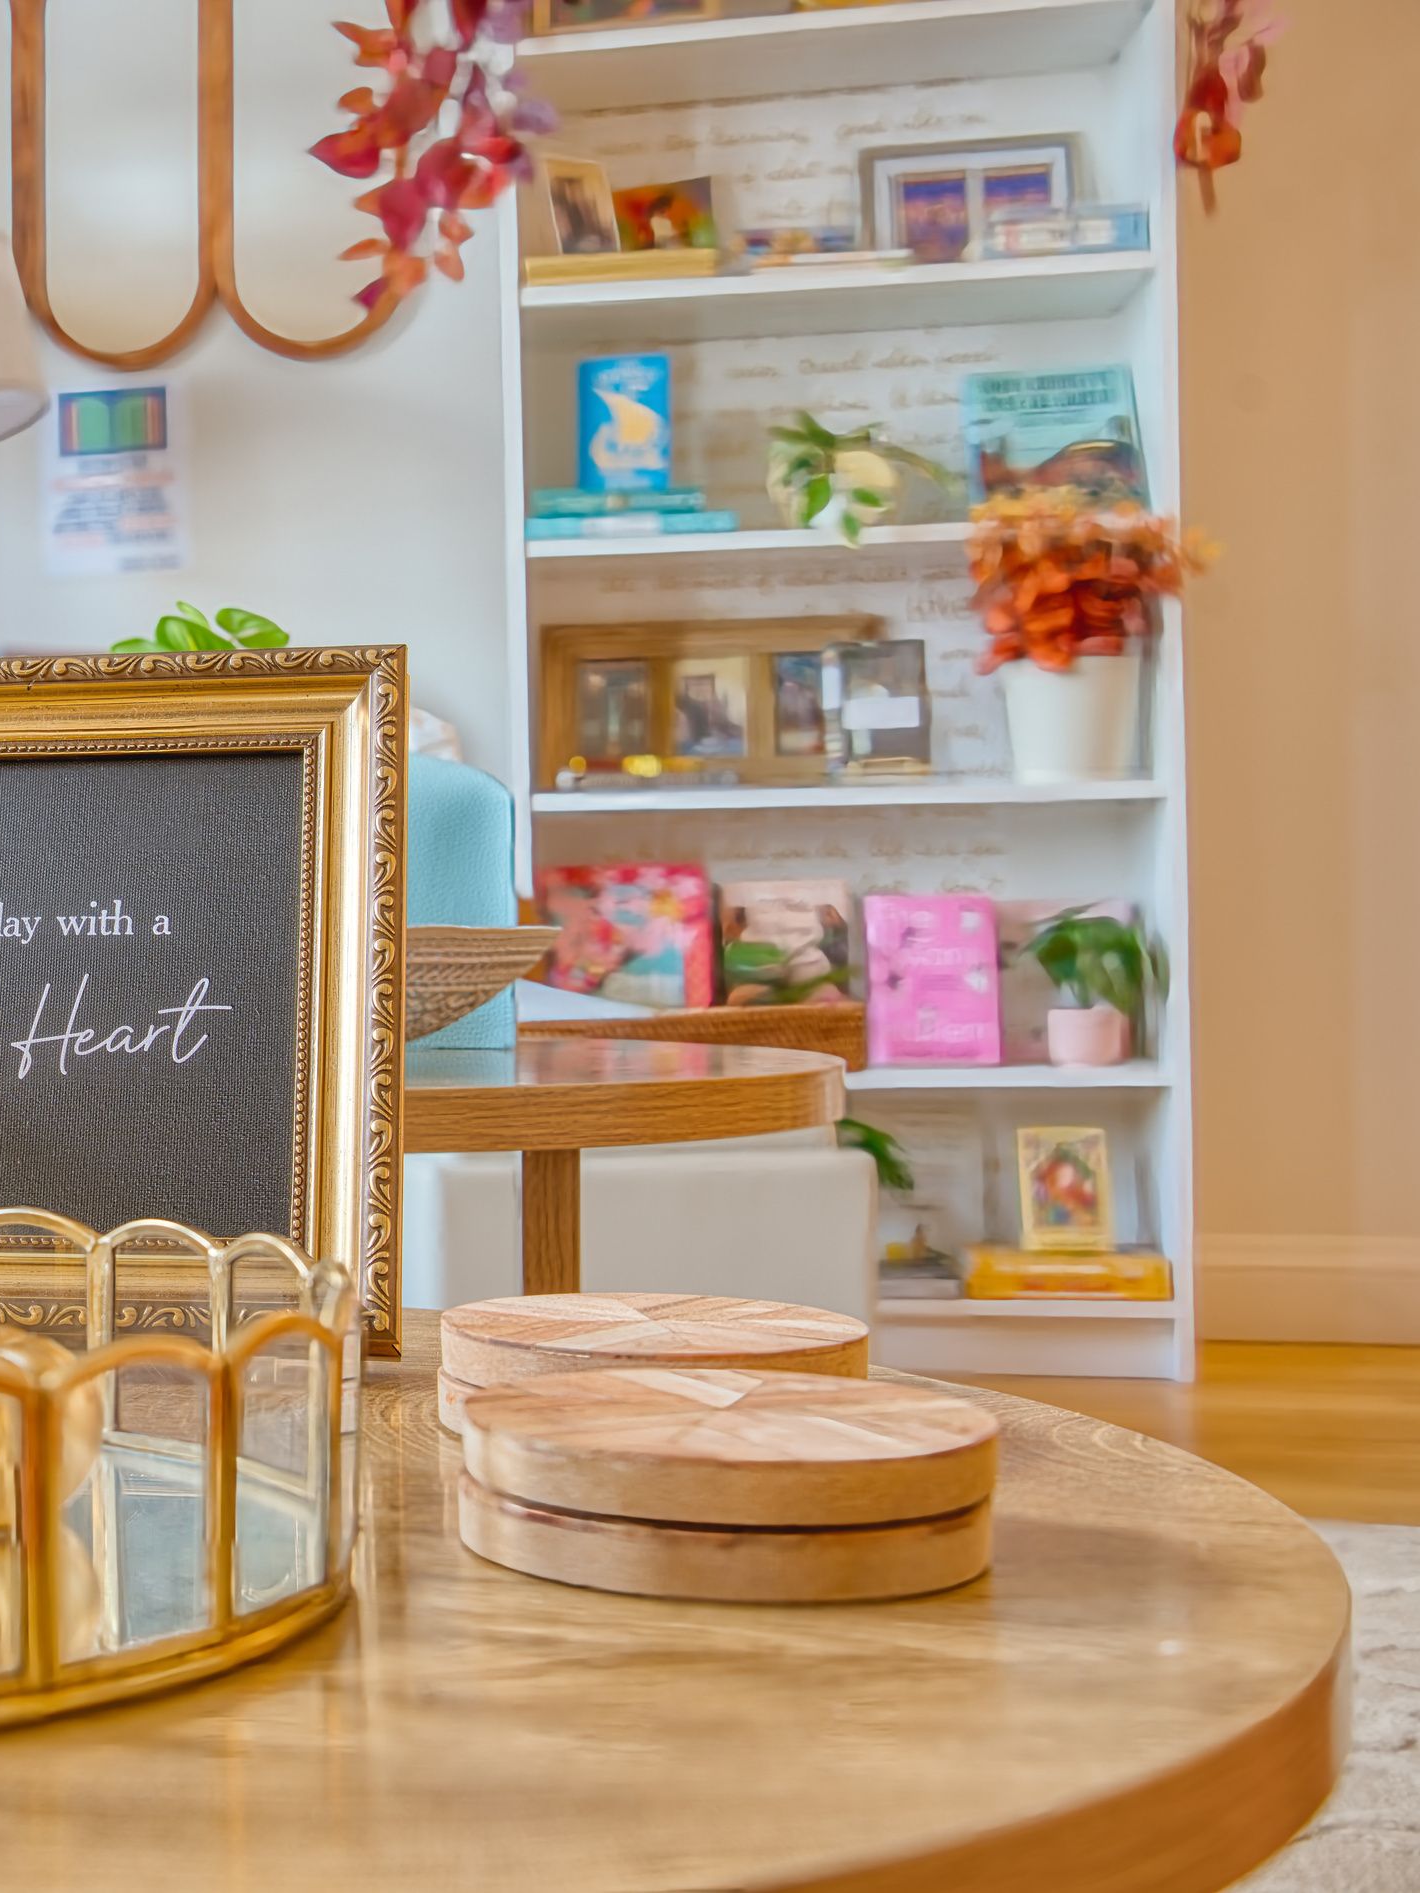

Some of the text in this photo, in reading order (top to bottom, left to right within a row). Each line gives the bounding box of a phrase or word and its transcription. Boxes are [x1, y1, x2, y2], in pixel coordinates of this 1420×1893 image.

[56, 899, 134, 937] with
[152, 915, 172, 936] a
[10, 973, 233, 1080] Heart
